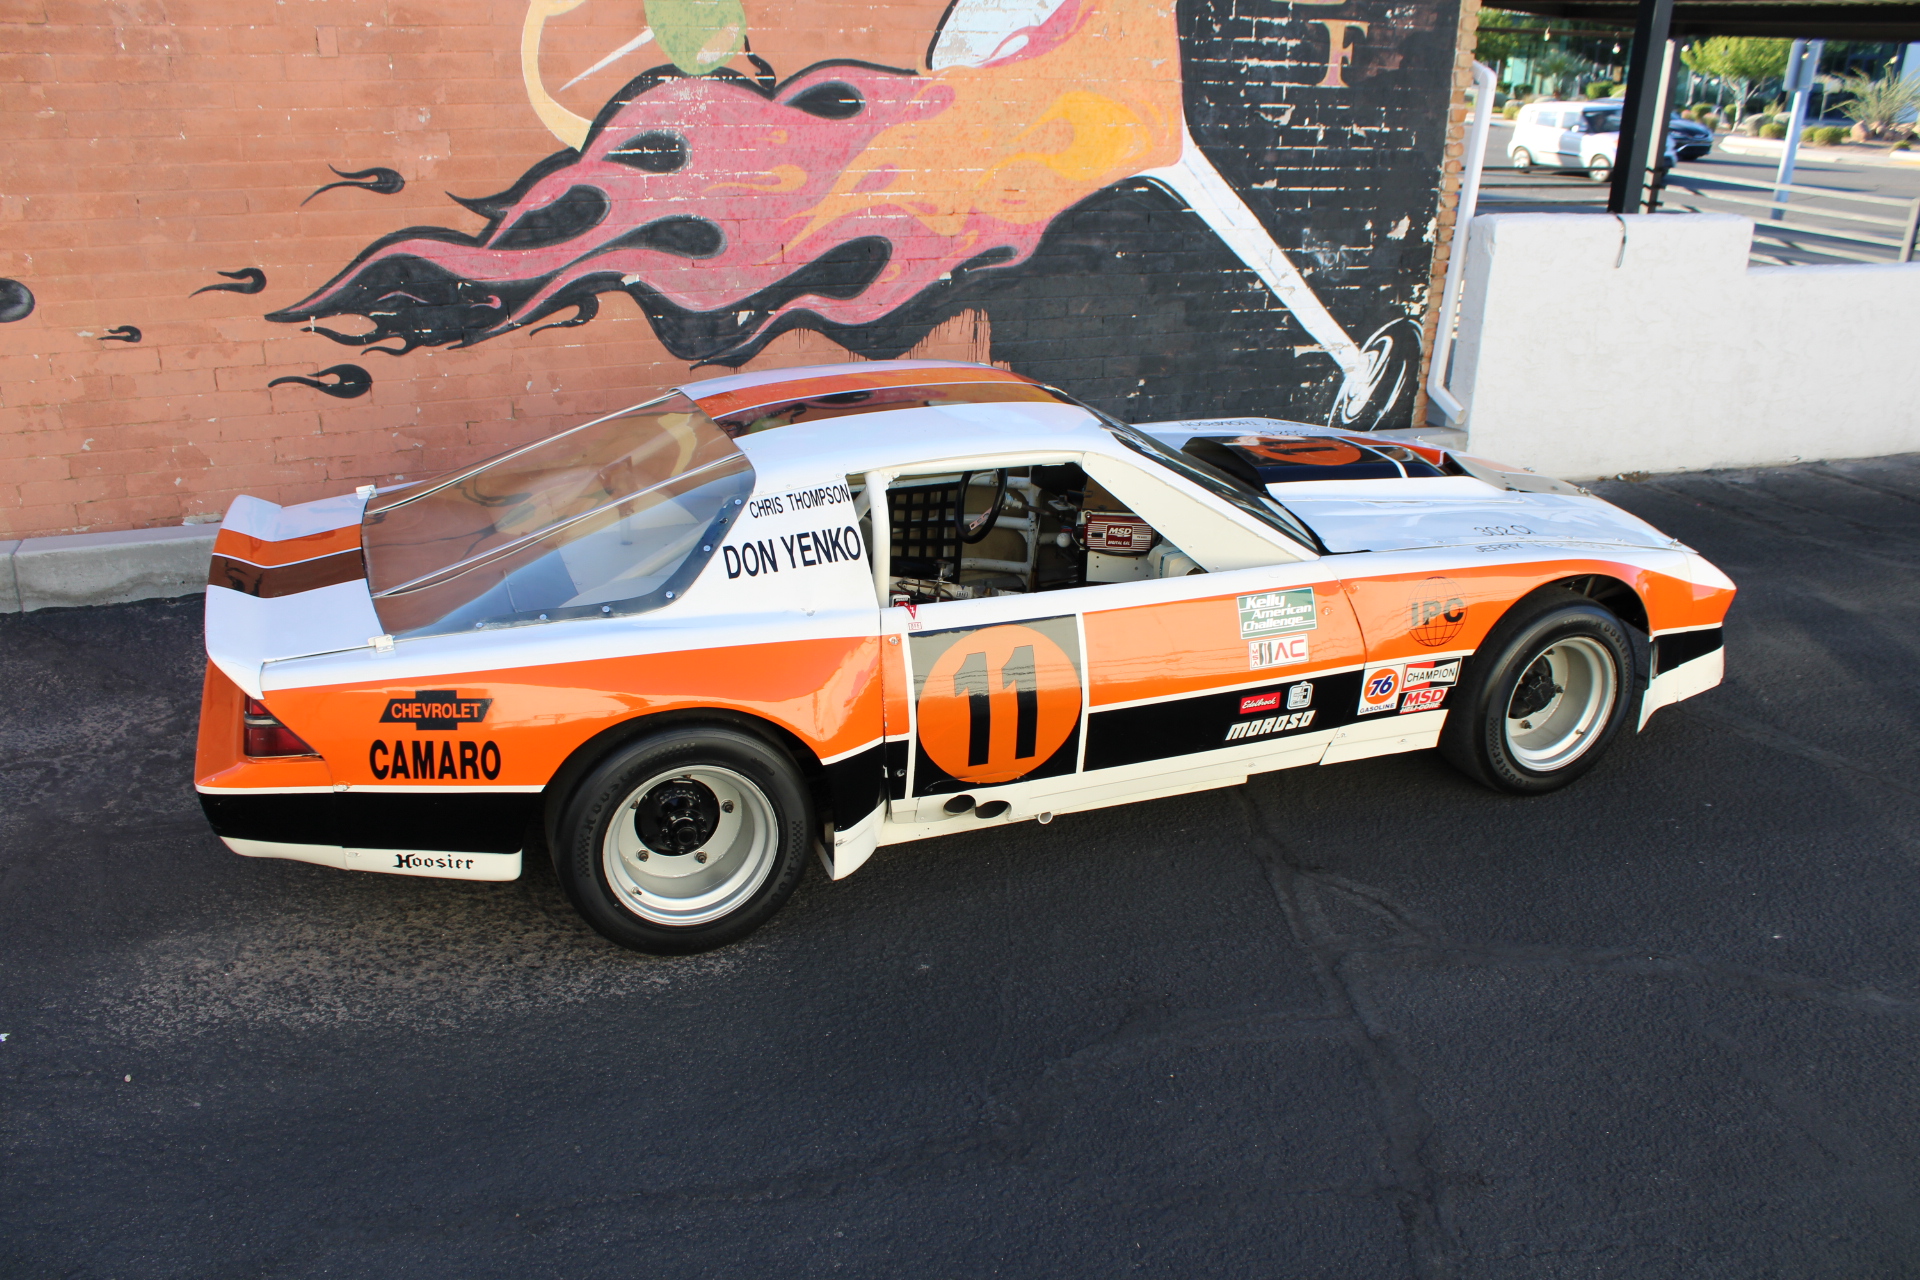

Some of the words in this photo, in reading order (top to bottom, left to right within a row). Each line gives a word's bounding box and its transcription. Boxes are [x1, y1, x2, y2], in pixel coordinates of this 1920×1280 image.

[1309, 19, 1370, 88] F
[750, 496, 784, 519] CHRIS
[786, 484, 851, 511] THOMPSON
[1108, 527, 1132, 535] MSD
[723, 539, 779, 580] DON
[780, 526, 861, 569] YENKO
[1245, 593, 1286, 610] Kelly
[1252, 603, 1312, 620] American
[1412, 597, 1464, 627] IPC
[1243, 616, 1304, 631] Challenge
[1406, 667, 1456, 683] CHAMPION
[1369, 675, 1394, 697] 76
[953, 645, 1038, 767] 11
[1242, 696, 1277, 709] Edelbrock
[1403, 689, 1445, 707] MSD
[391, 703, 481, 719] CHEVROLET
[1359, 703, 1395, 714] GASOLINE
[1225, 710, 1316, 741] MOROSO
[369, 739, 502, 781] CAMARO
[392, 853, 474, 870] Hoosier
